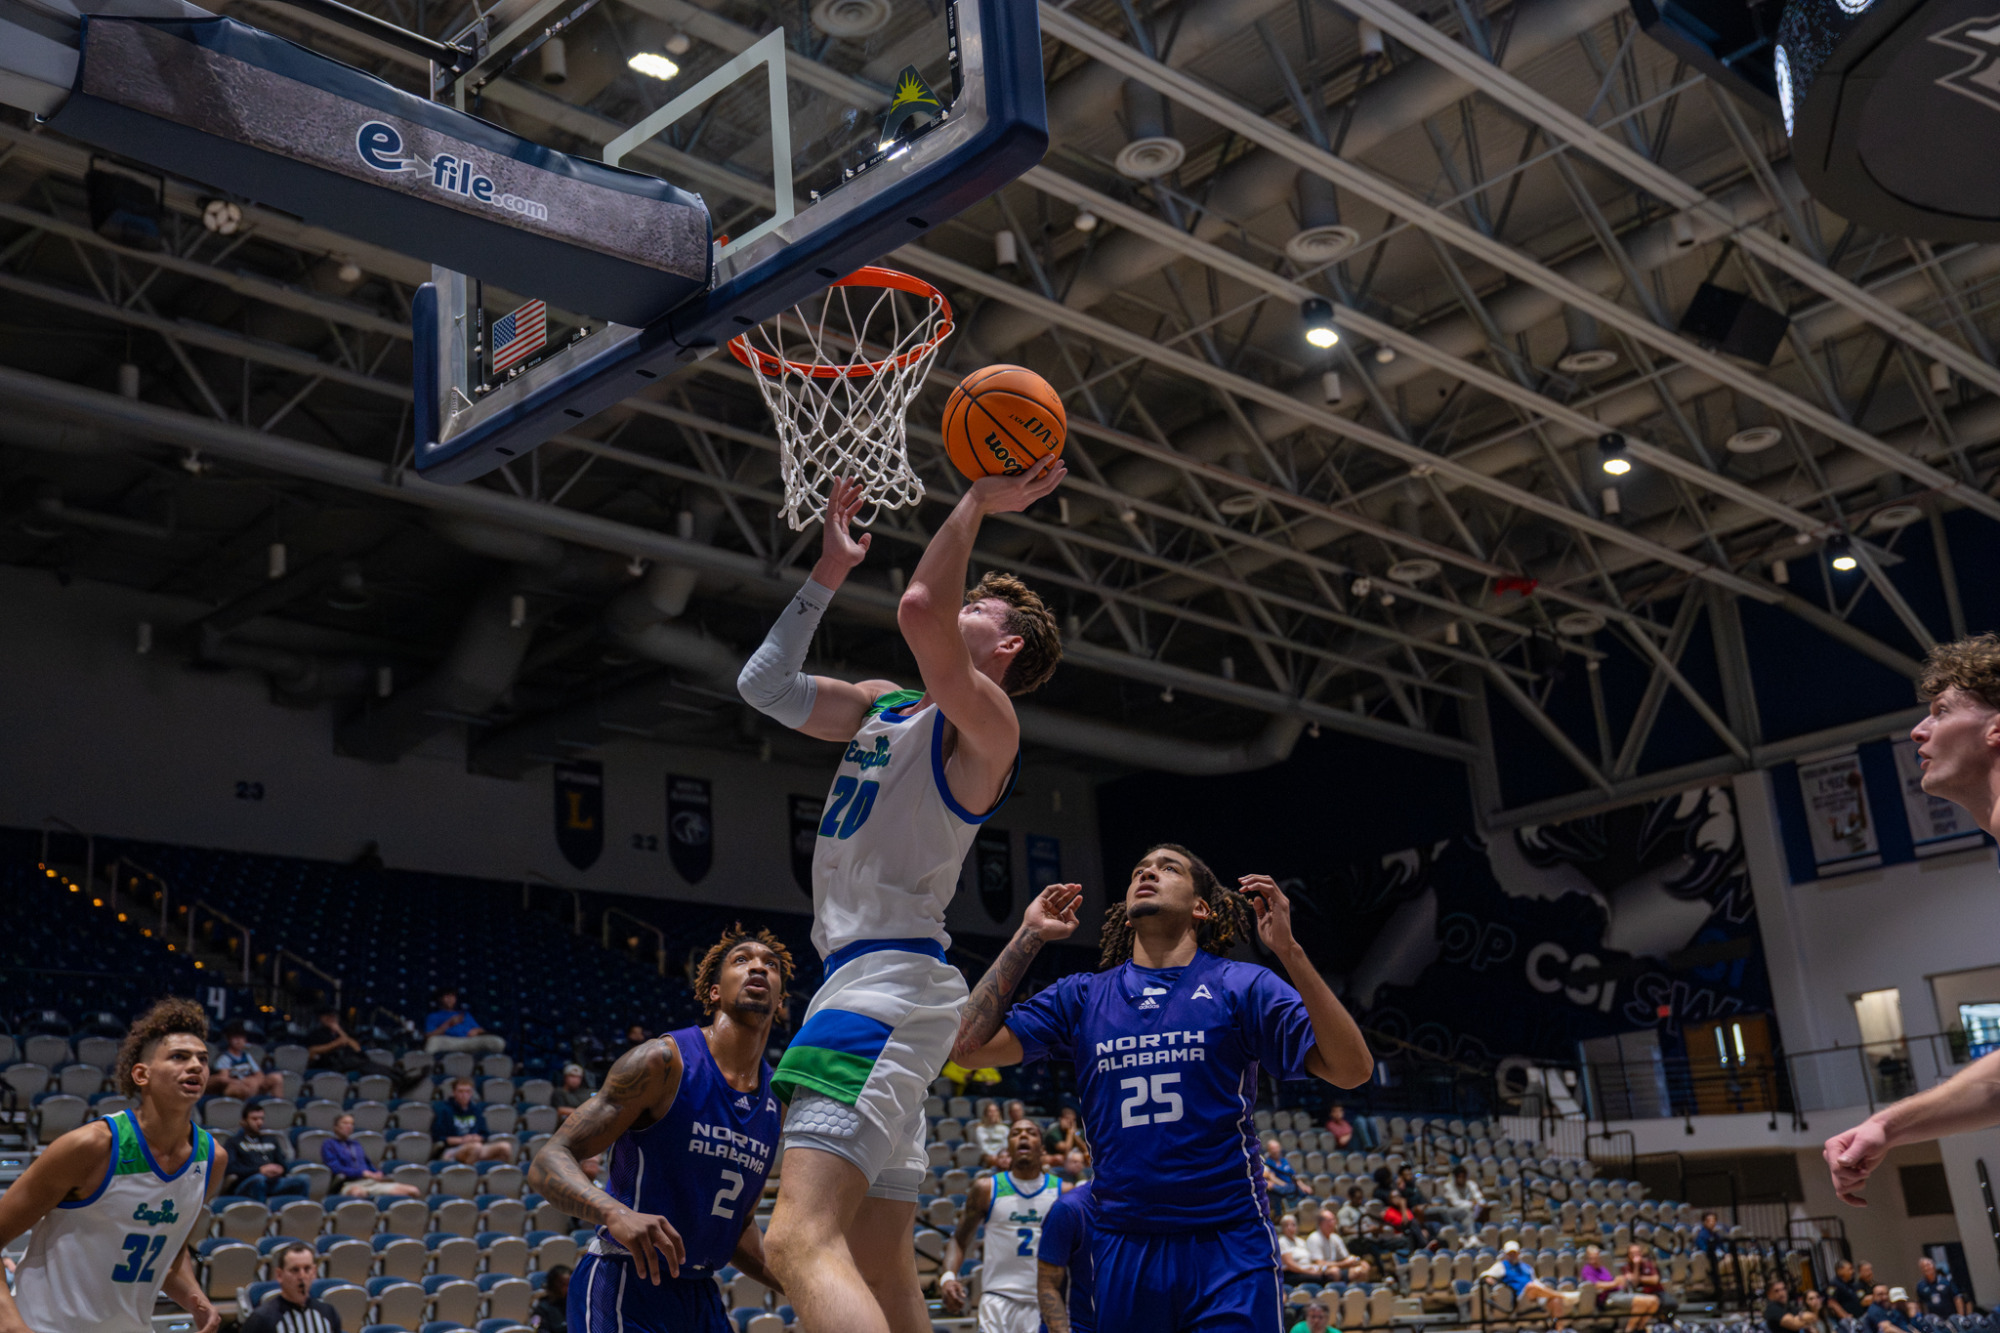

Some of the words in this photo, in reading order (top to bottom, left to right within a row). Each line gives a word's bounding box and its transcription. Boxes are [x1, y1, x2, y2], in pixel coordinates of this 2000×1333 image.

[1023, 416, 1059, 451] EVO
[844, 735, 892, 771] Eagles
[236, 781, 264, 800] 23
[818, 775, 880, 840] 20
[565, 791, 593, 831] L
[206, 986, 227, 1020] 4
[1096, 1030, 1205, 1056] NORTH
[1097, 1048, 1206, 1074] ALABAMA
[1120, 1072, 1184, 1129] 25
[688, 1138, 765, 1175] ALABAMA
[691, 1121, 770, 1159] NORTH
[710, 1169, 744, 1219] 2
[111, 1233, 167, 1283] 32
[1017, 1228, 1033, 1256] 2
